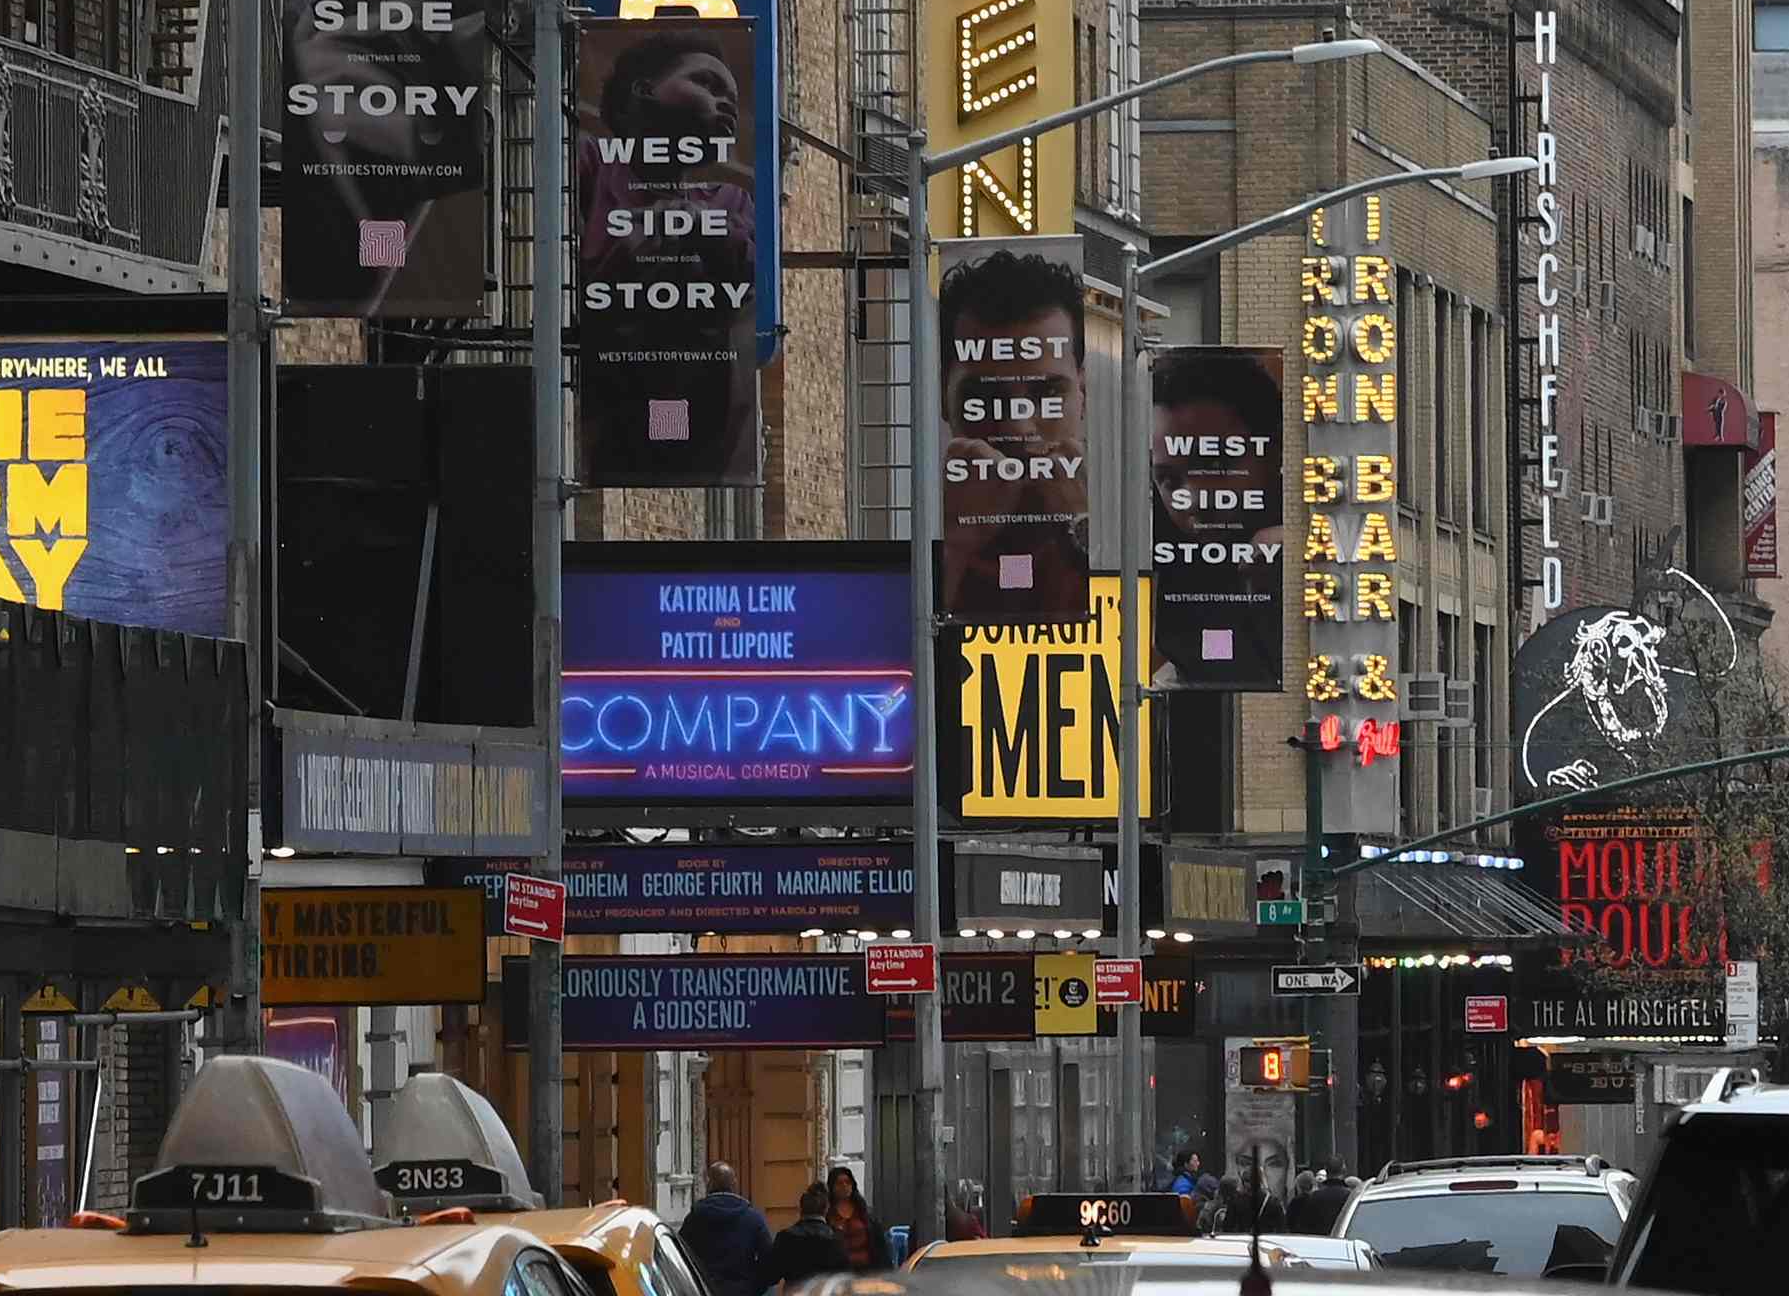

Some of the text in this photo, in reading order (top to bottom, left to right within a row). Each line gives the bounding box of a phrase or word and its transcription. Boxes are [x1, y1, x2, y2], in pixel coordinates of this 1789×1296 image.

[314, 0, 453, 33] SIDE
[287, 85, 479, 117] STORY
[599, 137, 736, 165] WEST
[302, 163, 463, 177] WESTSIDESTORYBWAY.COM
[607, 210, 728, 238] SIDE
[585, 281, 752, 311] STORY
[1355, 196, 1396, 425] IRON
[1535, 11, 1562, 608] HIRSCHFELD
[598, 351, 738, 364] WESTSIDESTORYBWAY.COM
[955, 337, 1069, 362] WEST
[100, 357, 126, 378] WE
[133, 356, 167, 377] ALL
[964, 396, 1063, 422] SIDE
[1164, 436, 1270, 457] WEST
[946, 456, 1083, 483] STORY
[1172, 489, 1265, 511] SIDE
[1355, 454, 1397, 622] BAR
[1154, 543, 1282, 564] STORY
[660, 586, 796, 615] KATRINA LENK
[715, 617, 740, 627] AND
[661, 631, 794, 660] PATTI LUPONE
[561, 686, 908, 754] COMPANY
[645, 763, 811, 780] A MUSICAL COMEDY
[818, 857, 890, 868] DIRECTED BY
[509, 881, 521, 893] NO
[522, 882, 556, 899] STANDING
[642, 871, 763, 897] GEORGE FURTH
[777, 869, 863, 896] MARIANNE
[509, 894, 539, 909] Anytime
[1268, 904, 1277, 921] 8
[292, 900, 455, 938] MASTERFUL
[870, 948, 924, 959] NO STANDING
[870, 959, 905, 972] Anytime
[671, 967, 855, 998] TRANSFORMATIVE.
[1285, 974, 1347, 987] ONE WAY
[633, 1000, 756, 1030] A GODSEND."
[1532, 1000, 1565, 1027] THE
[1575, 999, 1597, 1027] AL
[191, 1172, 263, 1202] 7J11
[398, 1167, 465, 1192] 3N33
[1080, 1199, 1131, 1225] 9C60
